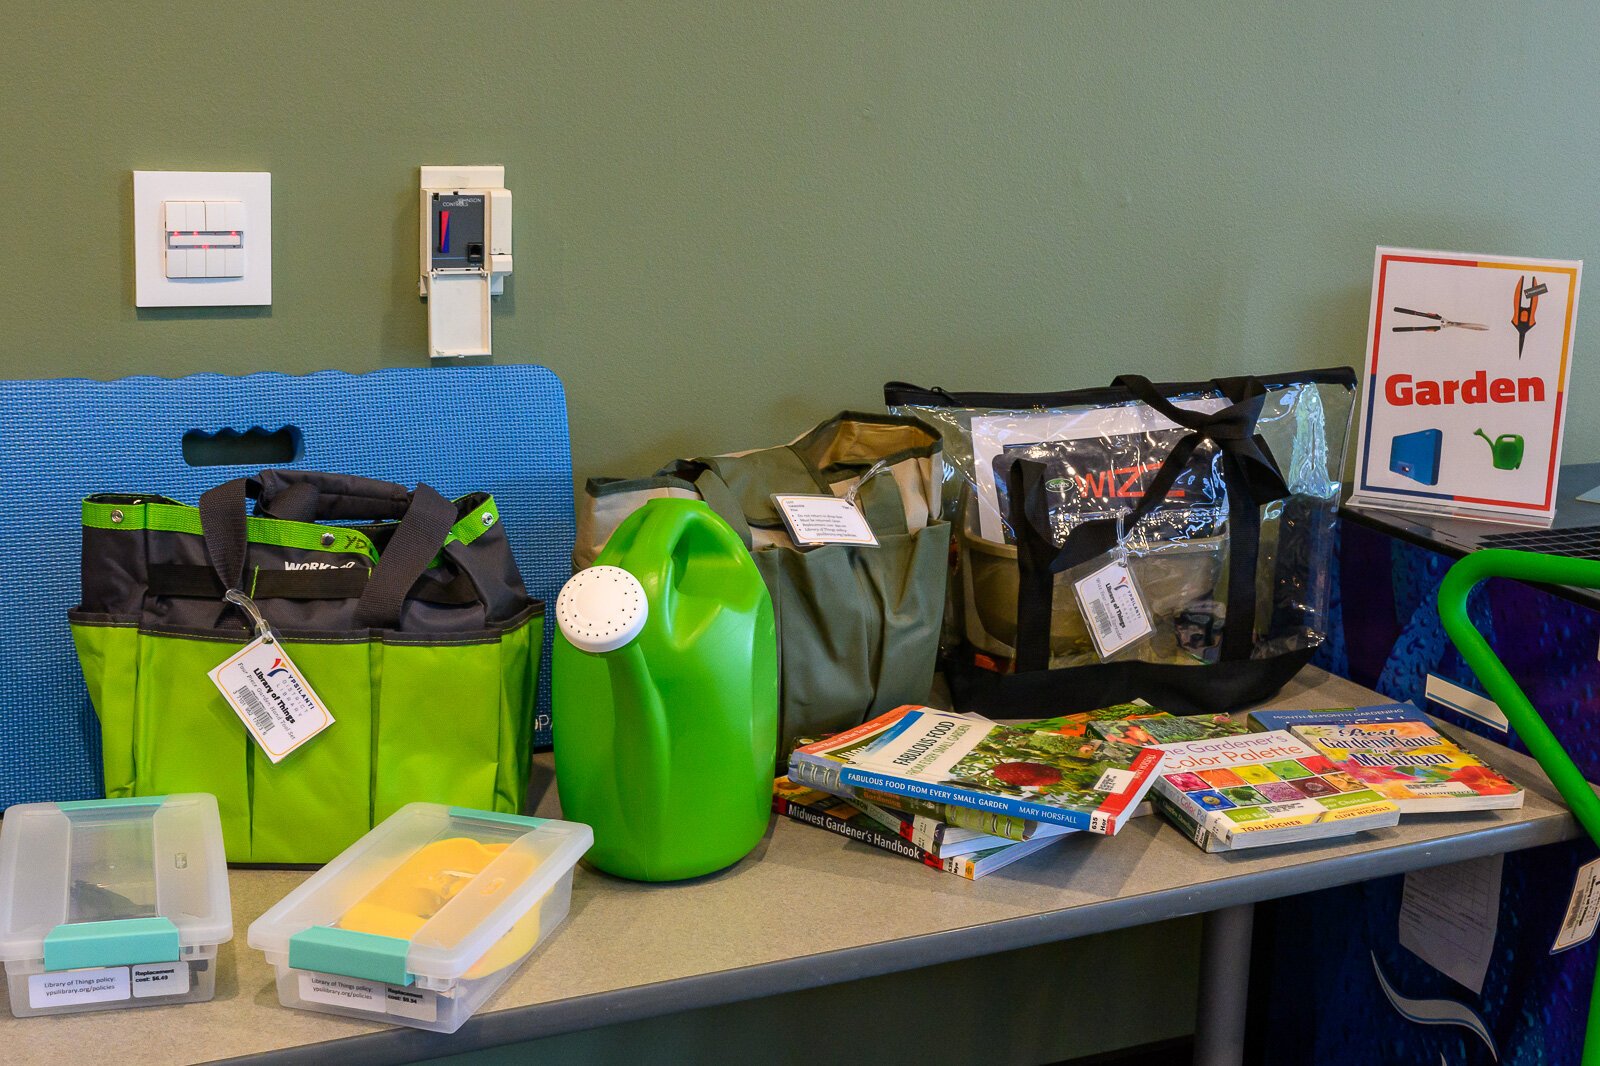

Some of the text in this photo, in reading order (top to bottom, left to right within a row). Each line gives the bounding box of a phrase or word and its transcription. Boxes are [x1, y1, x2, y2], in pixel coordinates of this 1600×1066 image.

[1384, 370, 1545, 407] Garden
[1105, 582, 1126, 629] Library of Things
[1127, 590, 1141, 619] YPSILANTI
[253, 667, 296, 724] Library of Things
[276, 684, 302, 717] LIBRARY
[281, 679, 309, 713] DISTRICT
[287, 674, 315, 710] YPSILANTI
[237, 662, 296, 740] Four Piece Garden Hand Tool Set
[1353, 708, 1404, 717] GARDENING
[947, 724, 972, 741] GARDEN
[1338, 727, 1396, 738] Best
[892, 737, 938, 766] FABULOUS
[925, 721, 955, 739] FOOD
[1164, 734, 1289, 757] he Gardener's
[1318, 734, 1442, 750] Garden Plants
[1221, 744, 1305, 765] Palette
[1350, 750, 1454, 767] Michigan
[847, 773, 884, 787] FABULOUS
[885, 780, 906, 791] FOOD
[906, 784, 929, 795] FROM
[928, 788, 951, 800] EVERY
[953, 793, 977, 805] SMALL
[978, 798, 1009, 811] GARDEN
[1180, 795, 1196, 816] Color
[1334, 806, 1391, 819] CLIVE NICHOLS
[1018, 806, 1078, 824] MARY HORSFALL
[788, 803, 824, 826] Midwest
[826, 817, 872, 843] Gardener's
[873, 833, 920, 860] Handbook
[1099, 818, 1107, 831] Hor
[1241, 819, 1303, 833] TOM FISCHER
[134, 968, 175, 977] Replacement
[151, 974, 169, 982] $6.49
[44, 976, 116, 989] Library of Things policy:
[46, 984, 115, 997] ypsilibrary.org/policies
[311, 978, 331, 987] Library
[337, 981, 355, 991] Things
[355, 984, 373, 993] policy:
[312, 986, 373, 1000] ypsilibrary.org/policies
[387, 987, 423, 999] Replacement
